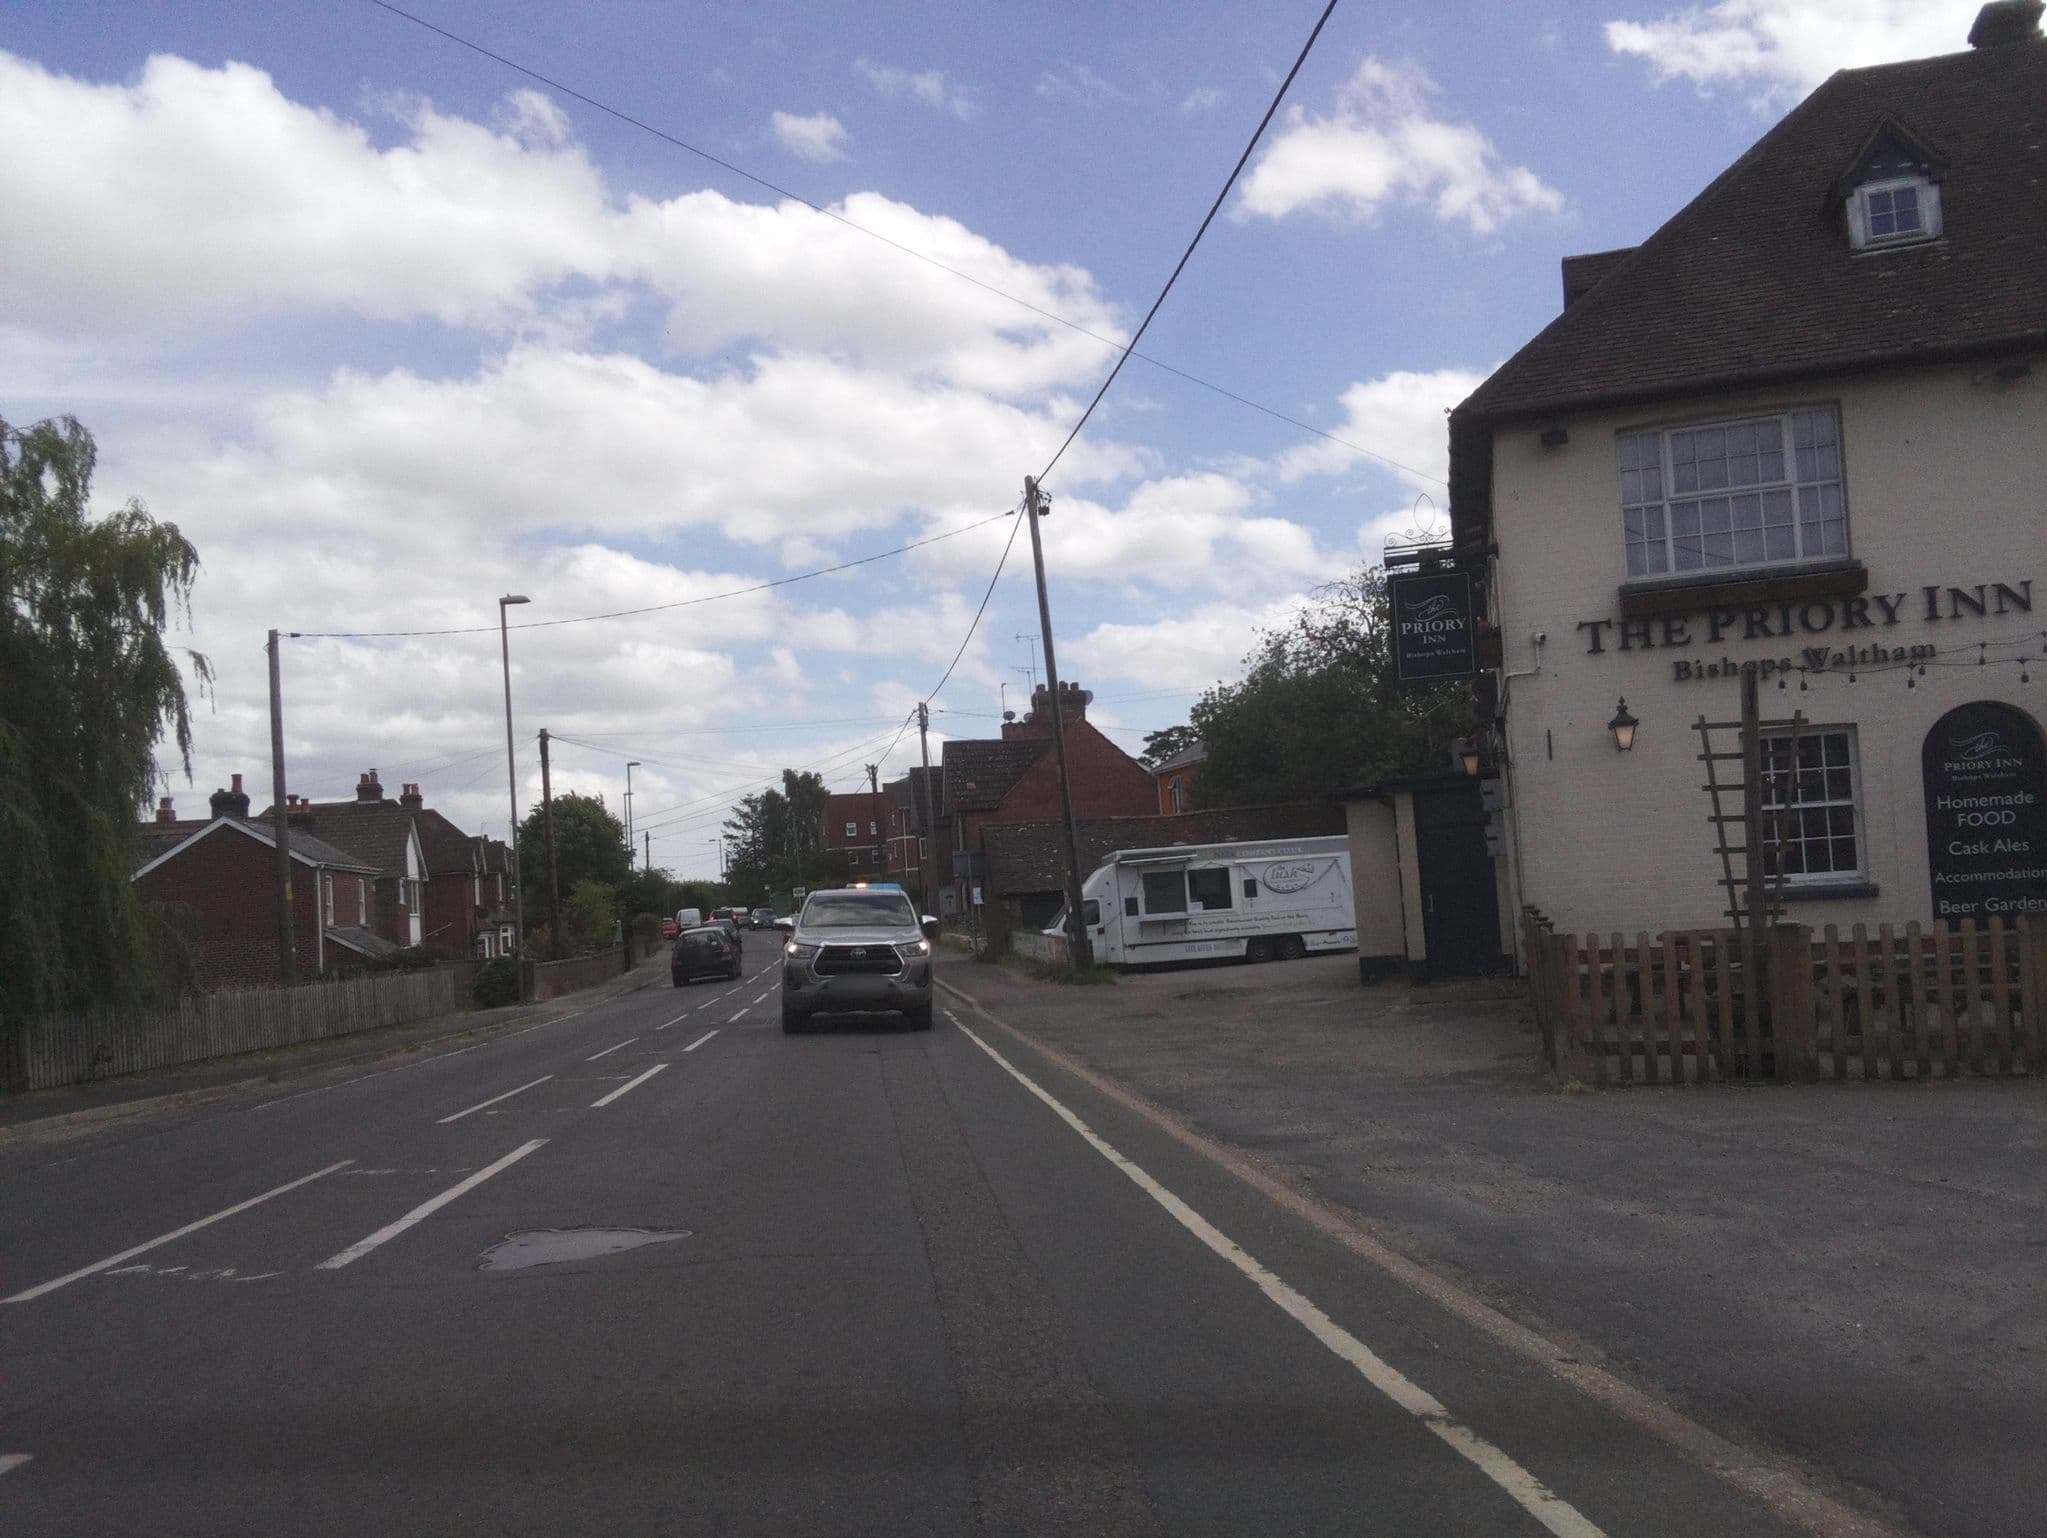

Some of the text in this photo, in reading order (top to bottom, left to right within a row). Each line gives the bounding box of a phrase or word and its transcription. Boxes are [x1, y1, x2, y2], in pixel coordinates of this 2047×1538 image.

[1577, 580, 2033, 653] THE PRIORY INN
[1401, 618, 1466, 635] PRIORY
[1423, 634, 1446, 644] INN
[1801, 643, 1937, 670] Waltham
[1944, 758, 2023, 771] PRIORY INN
[1936, 790, 2035, 810] Homemade
[1957, 810, 2017, 827] FOOD
[1948, 838, 2030, 856] Cask Ales
[1935, 867, 2047, 884] Accommodation
[1939, 896, 2047, 914] Beer Garden
